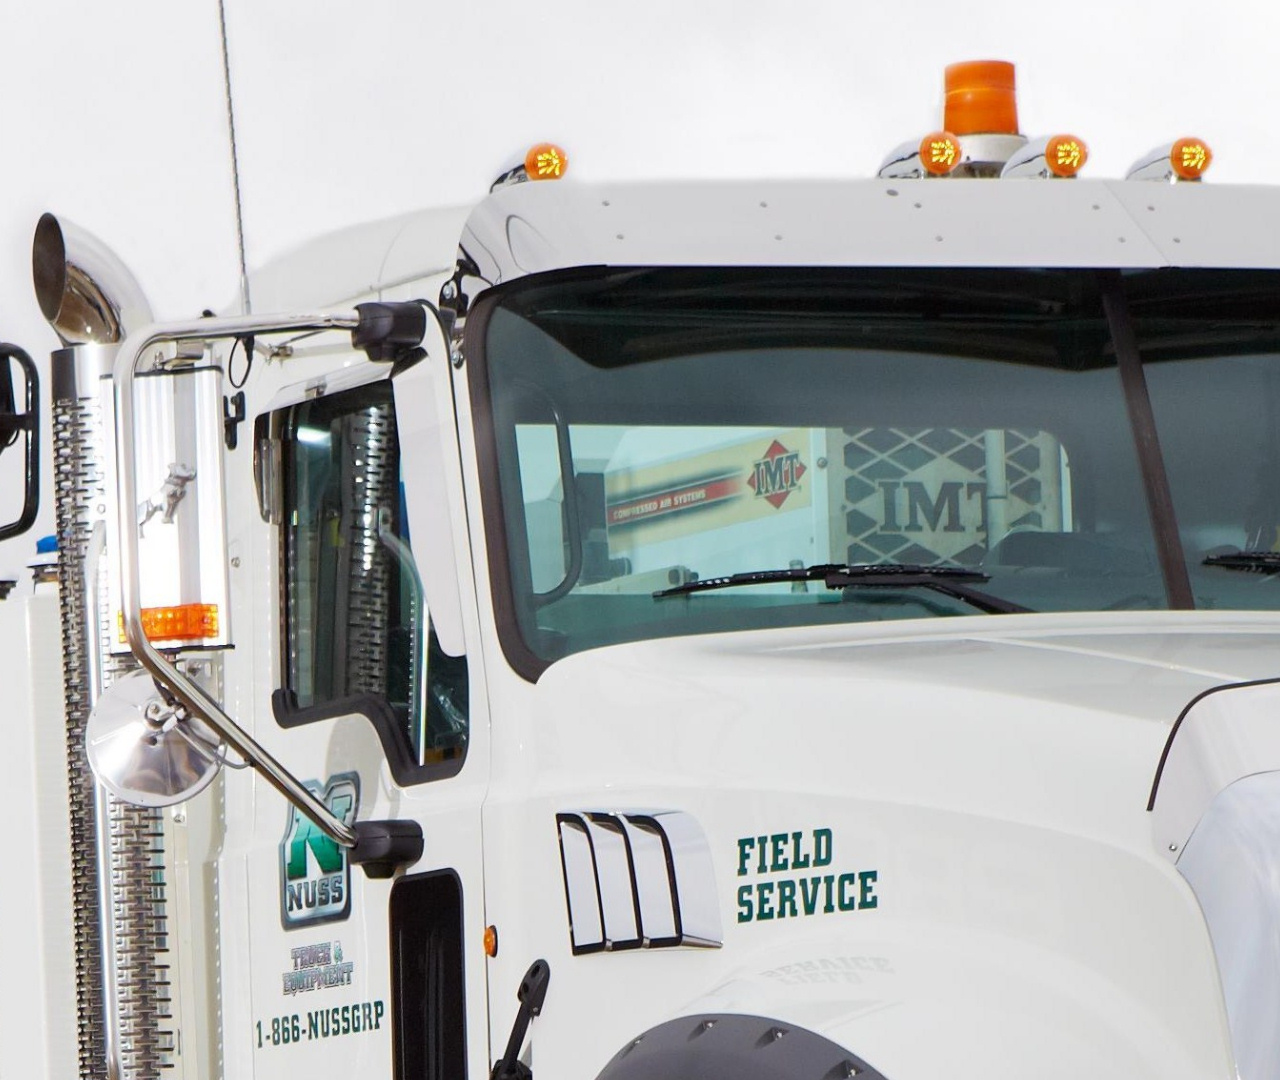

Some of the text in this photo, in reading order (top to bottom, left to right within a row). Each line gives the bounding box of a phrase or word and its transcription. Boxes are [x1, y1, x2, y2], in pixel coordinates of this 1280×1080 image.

[754, 452, 800, 496] IMT
[613, 502, 658, 520] COMPRESSED
[673, 489, 706, 506] SYSTEMS
[737, 828, 832, 876] FIELD
[288, 876, 344, 912] NUSS
[737, 870, 878, 923] SERVICE
[291, 942, 331, 970] TRUCK
[282, 961, 354, 996] EQUIPMENT
[256, 1000, 384, 1048] 1-866-NUSSGRP
